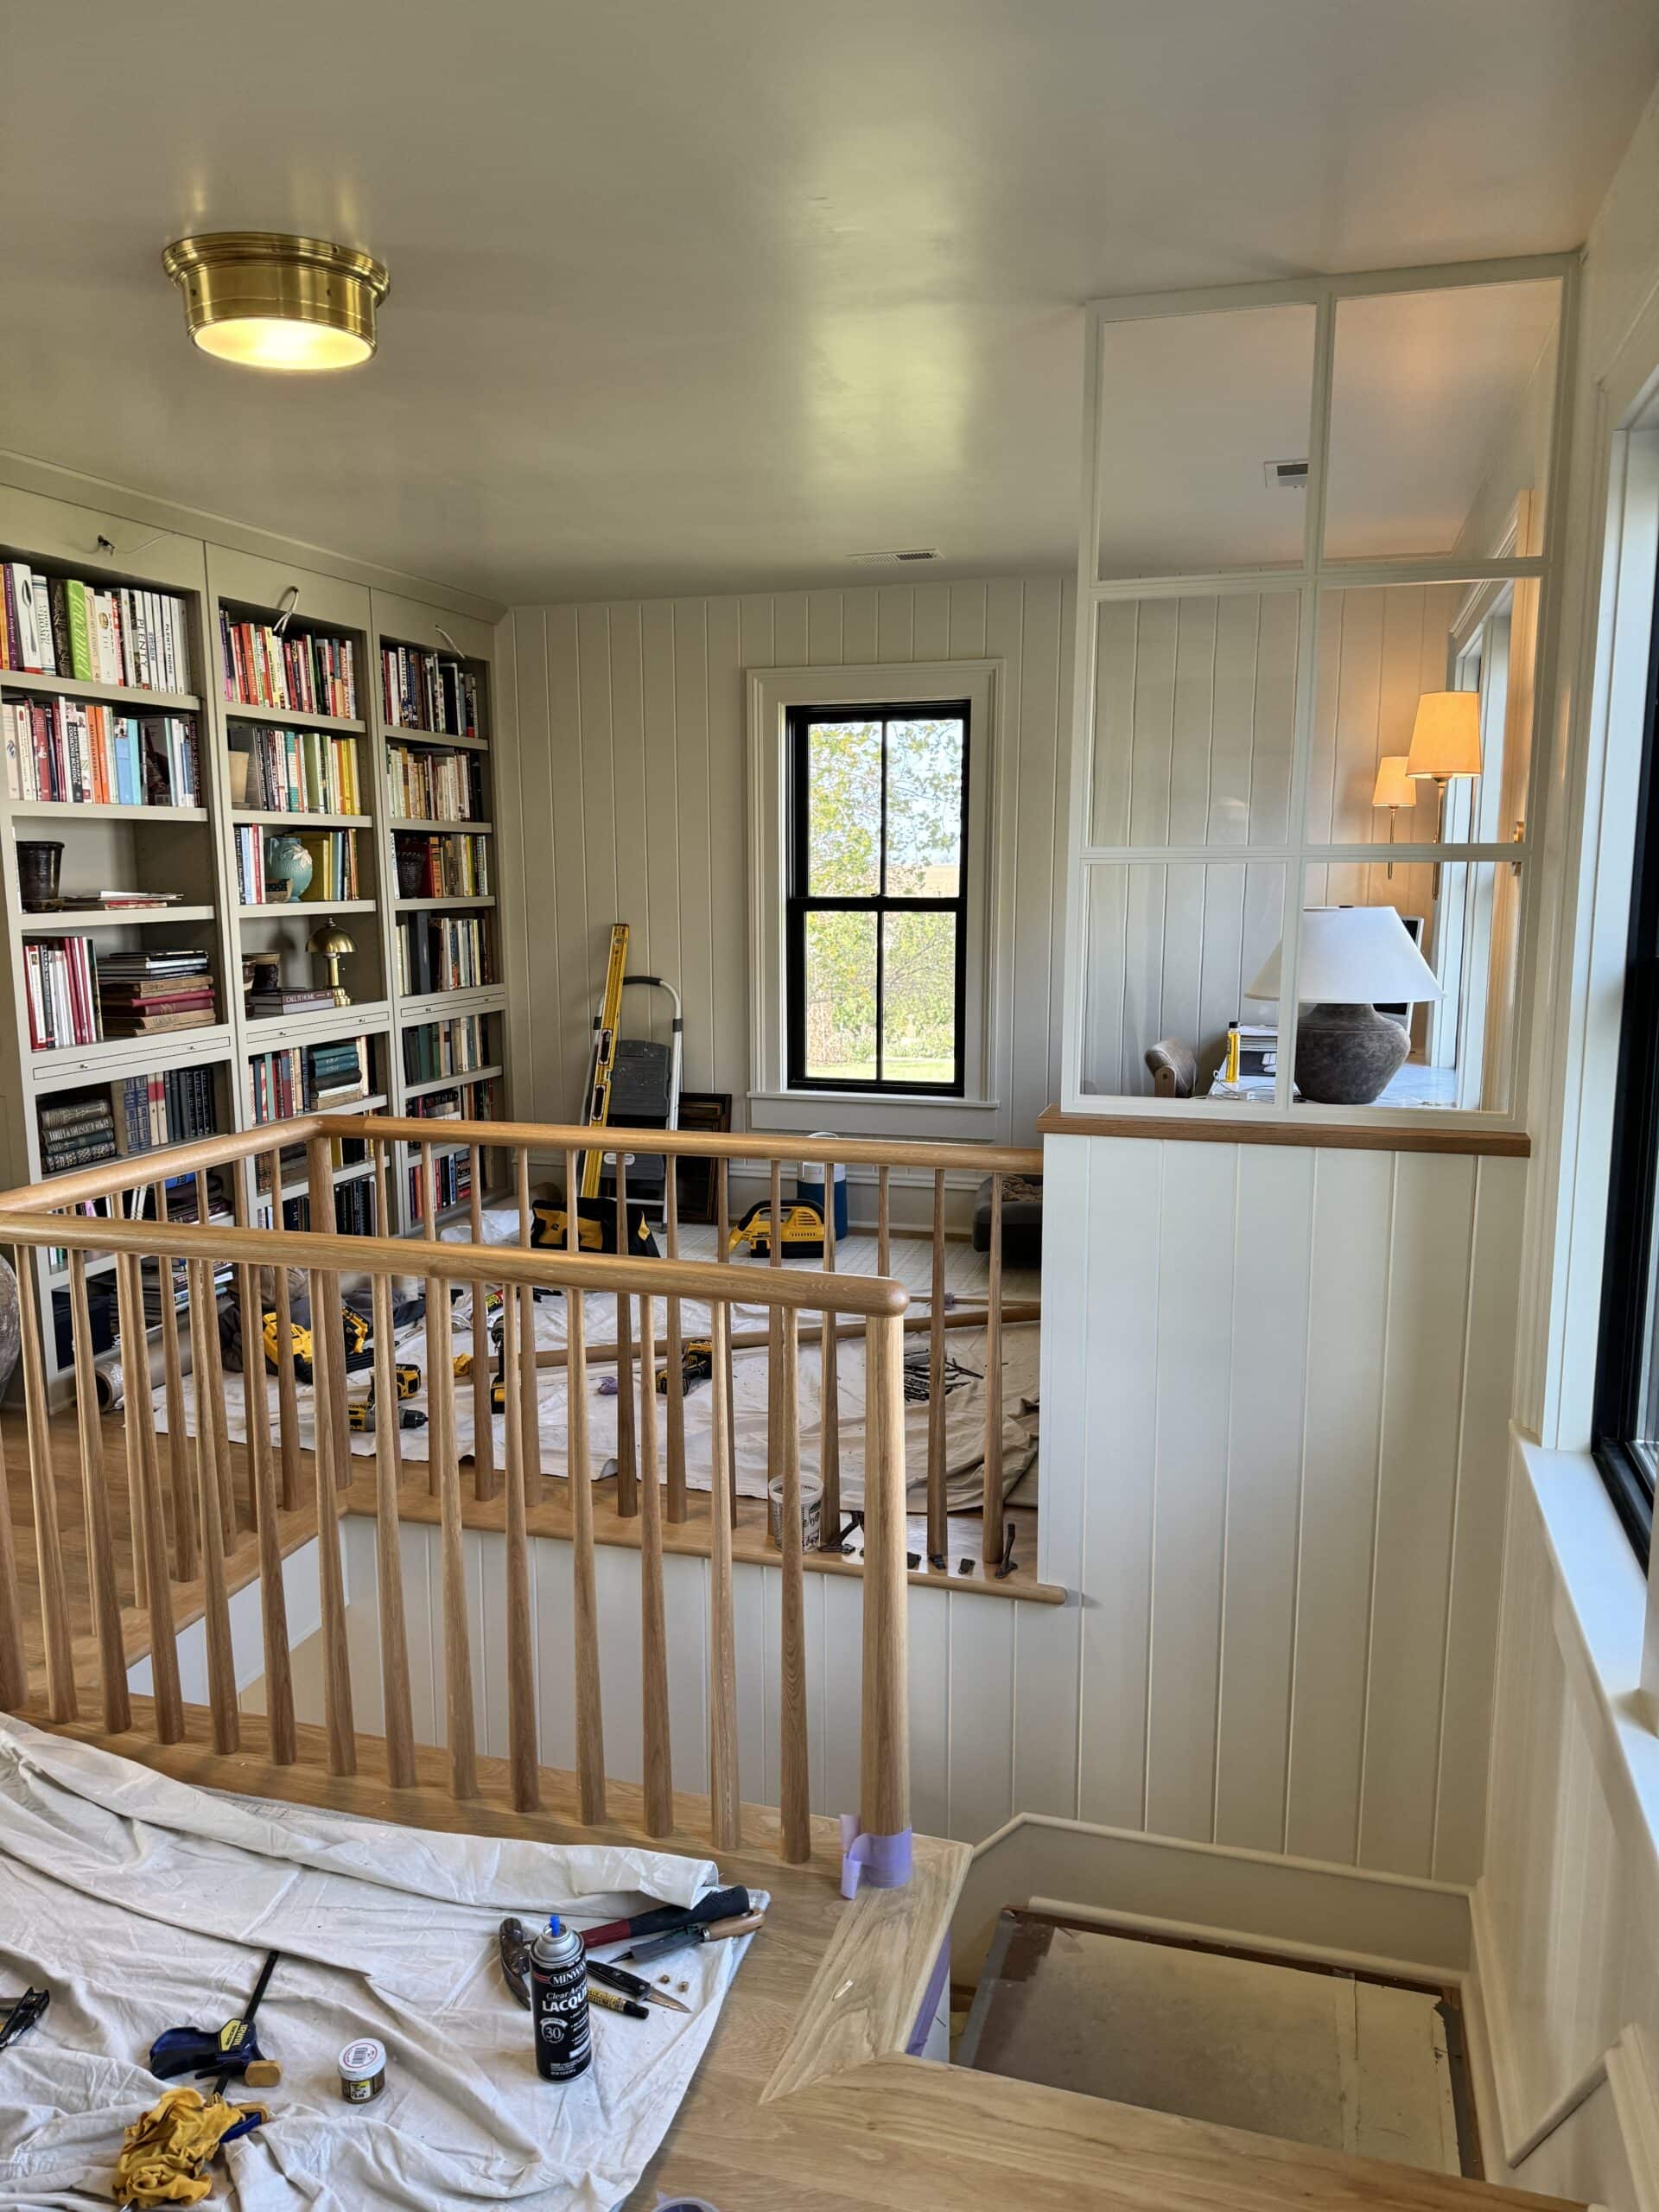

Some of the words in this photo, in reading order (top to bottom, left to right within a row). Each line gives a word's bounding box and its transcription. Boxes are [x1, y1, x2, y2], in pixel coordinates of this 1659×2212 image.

[70, 583, 90, 676] Gourmet
[137, 619, 148, 668] PLENTY
[554, 1961, 586, 1985] MINWA
[542, 1986, 588, 2012] LACQU
[546, 1991, 568, 1999] Clear
[232, 2024, 249, 2046] IRWIN
[546, 2027, 562, 2040] 30
